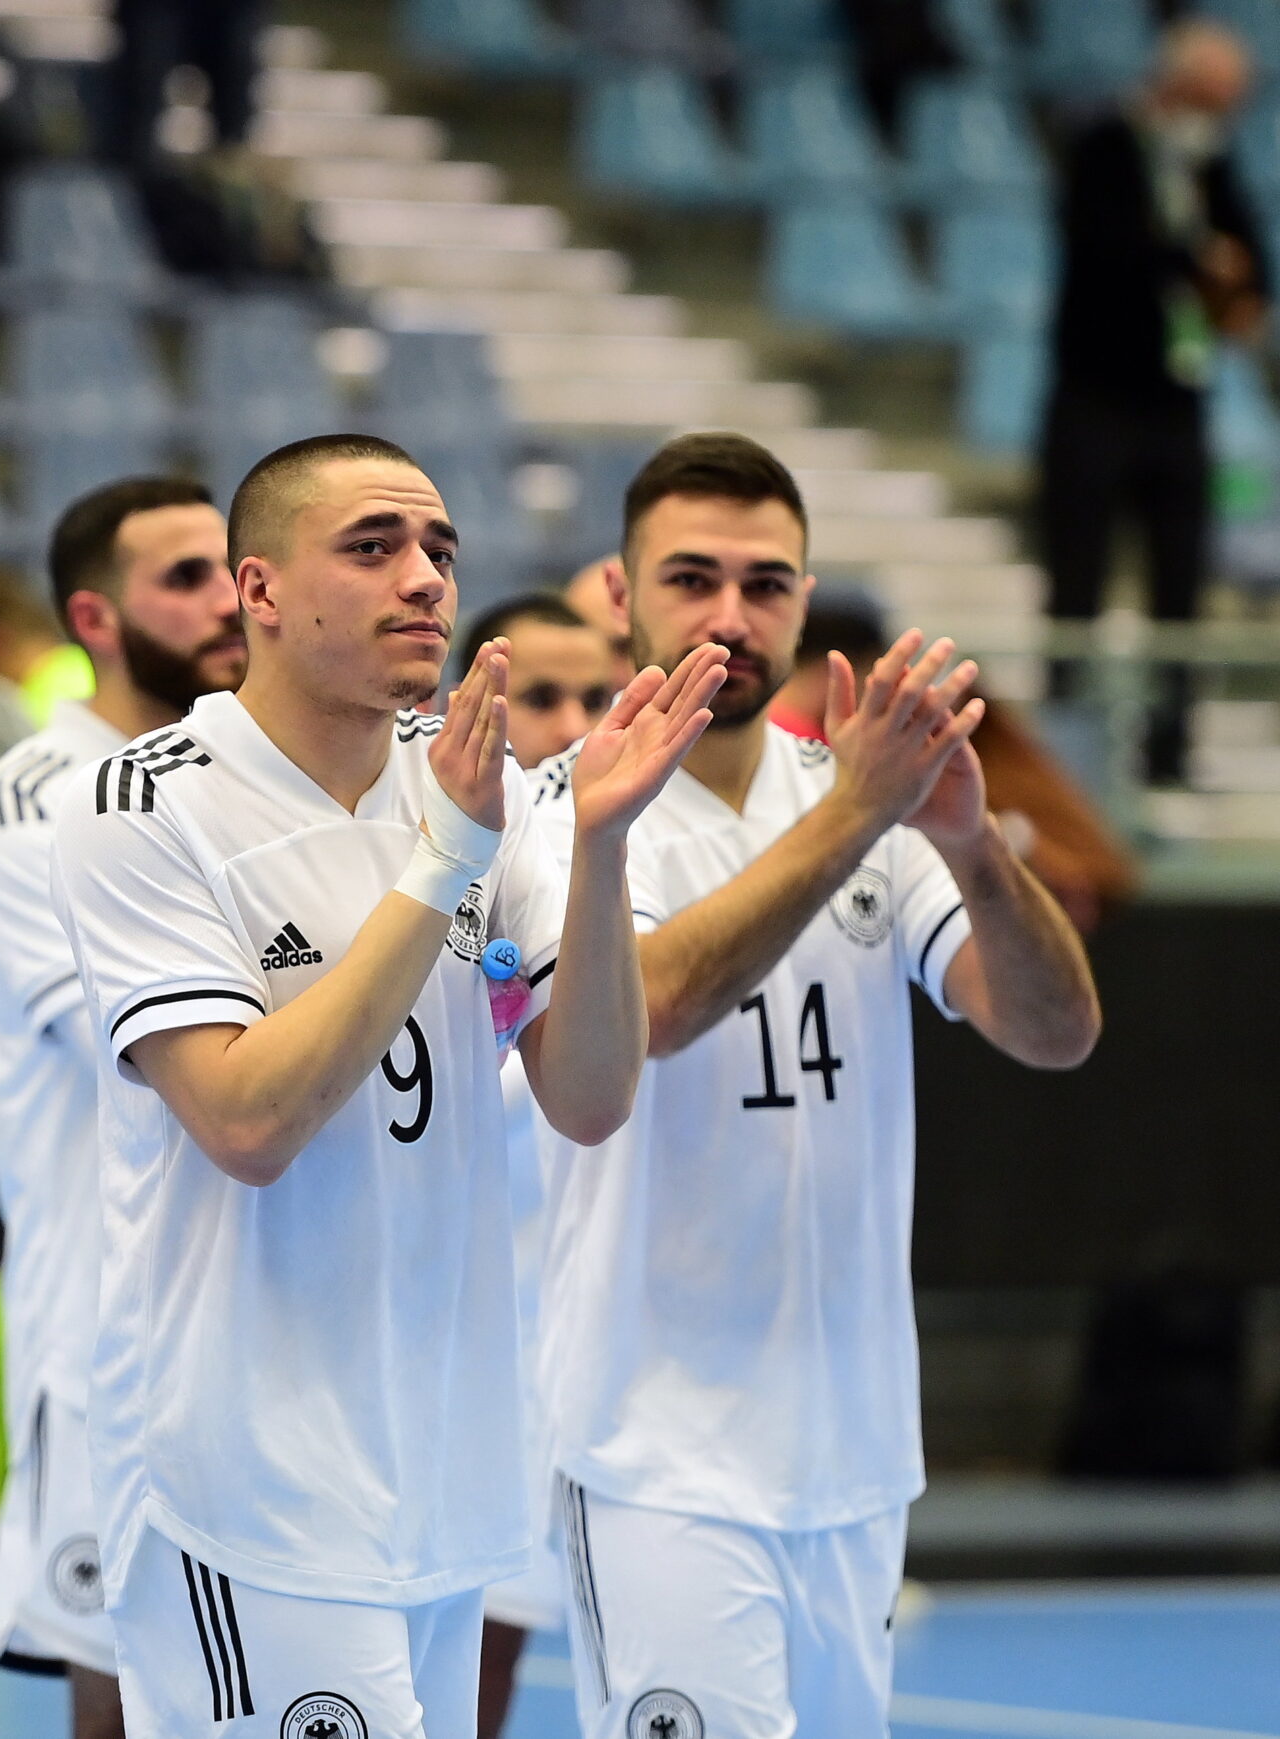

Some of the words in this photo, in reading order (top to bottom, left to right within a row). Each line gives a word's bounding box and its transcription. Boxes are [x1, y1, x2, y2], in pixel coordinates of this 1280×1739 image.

[260, 950, 323, 971] adidas
[380, 1014, 433, 1144] 9
[740, 982, 843, 1109] 14
[295, 1704, 346, 1724] DEUTSCHER
